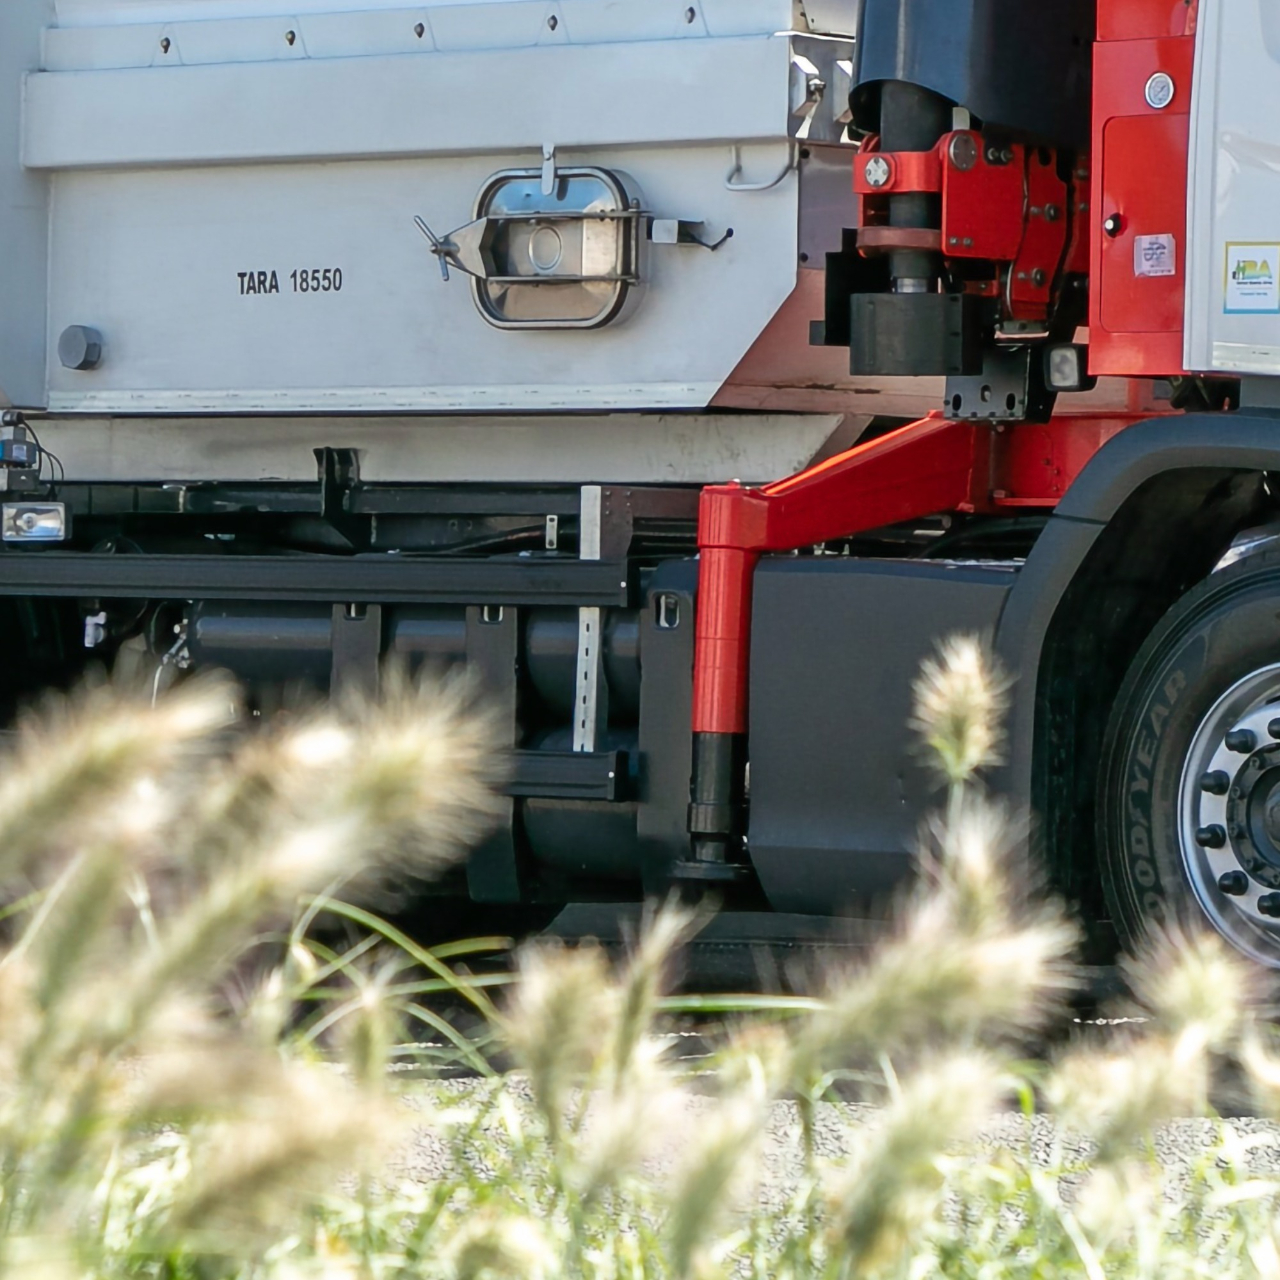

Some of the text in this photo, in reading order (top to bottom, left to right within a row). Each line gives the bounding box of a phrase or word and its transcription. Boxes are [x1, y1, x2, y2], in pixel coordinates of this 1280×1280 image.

[237, 267, 343, 295] TARA 18550
[1128, 668, 1187, 918] OODYEAR
